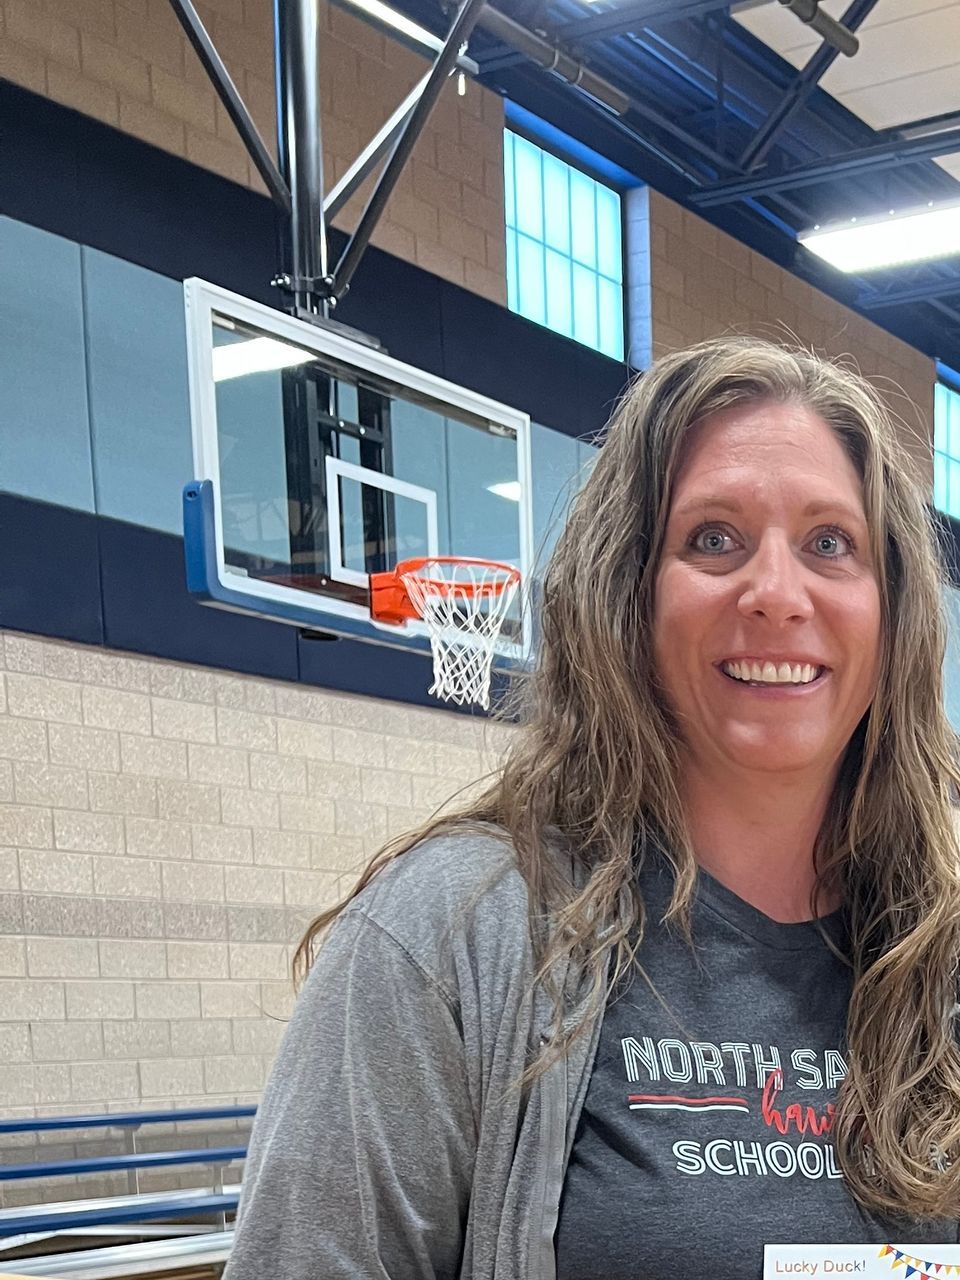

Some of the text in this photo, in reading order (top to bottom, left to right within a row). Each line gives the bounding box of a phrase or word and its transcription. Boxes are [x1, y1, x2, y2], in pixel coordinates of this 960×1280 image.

[621, 1036, 850, 1091] NORTH SA
[761, 1067, 837, 1137] haw
[672, 1139, 844, 1180] SCHOOL
[775, 1259, 866, 1276] Lucky Duck!
